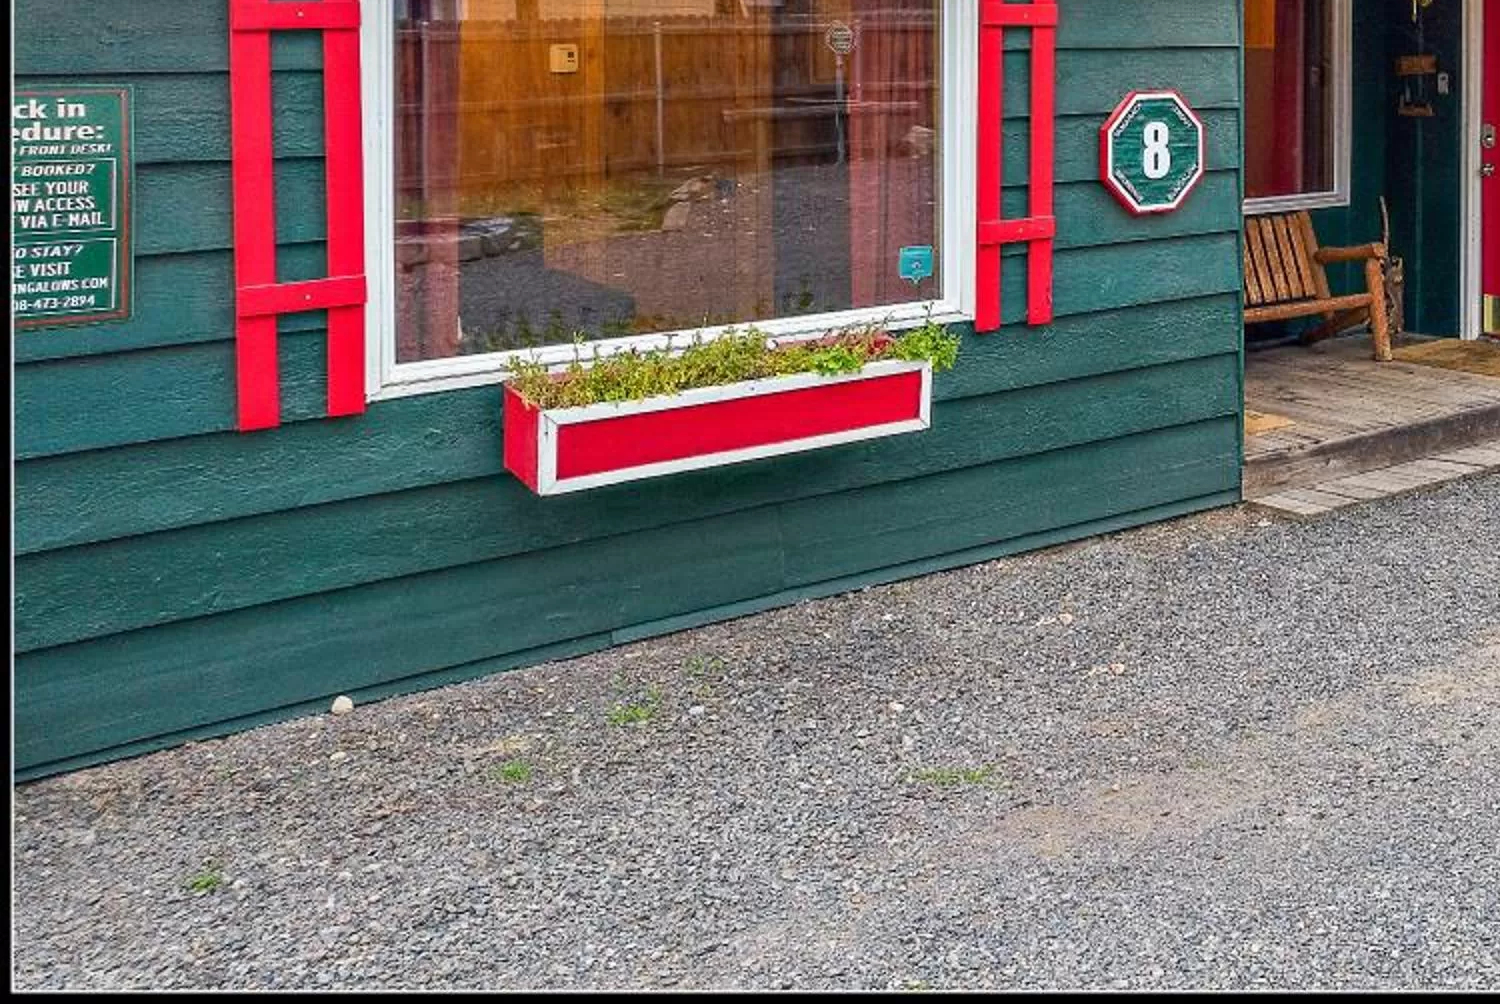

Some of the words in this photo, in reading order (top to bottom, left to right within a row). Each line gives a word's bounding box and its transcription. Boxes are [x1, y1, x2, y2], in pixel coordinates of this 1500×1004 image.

[14, 99, 48, 118] ck
[57, 98, 86, 117] in
[19, 145, 65, 155] FRONT
[1143, 121, 1171, 179] 8
[21, 164, 95, 177] BOOKED?
[46, 180, 89, 195] YOUR
[34, 196, 95, 212] ACCESS
[21, 215, 48, 228] VIA
[52, 211, 105, 227] E-MAIL
[31, 244, 84, 258] STAY?
[30, 261, 72, 276] VISIT
